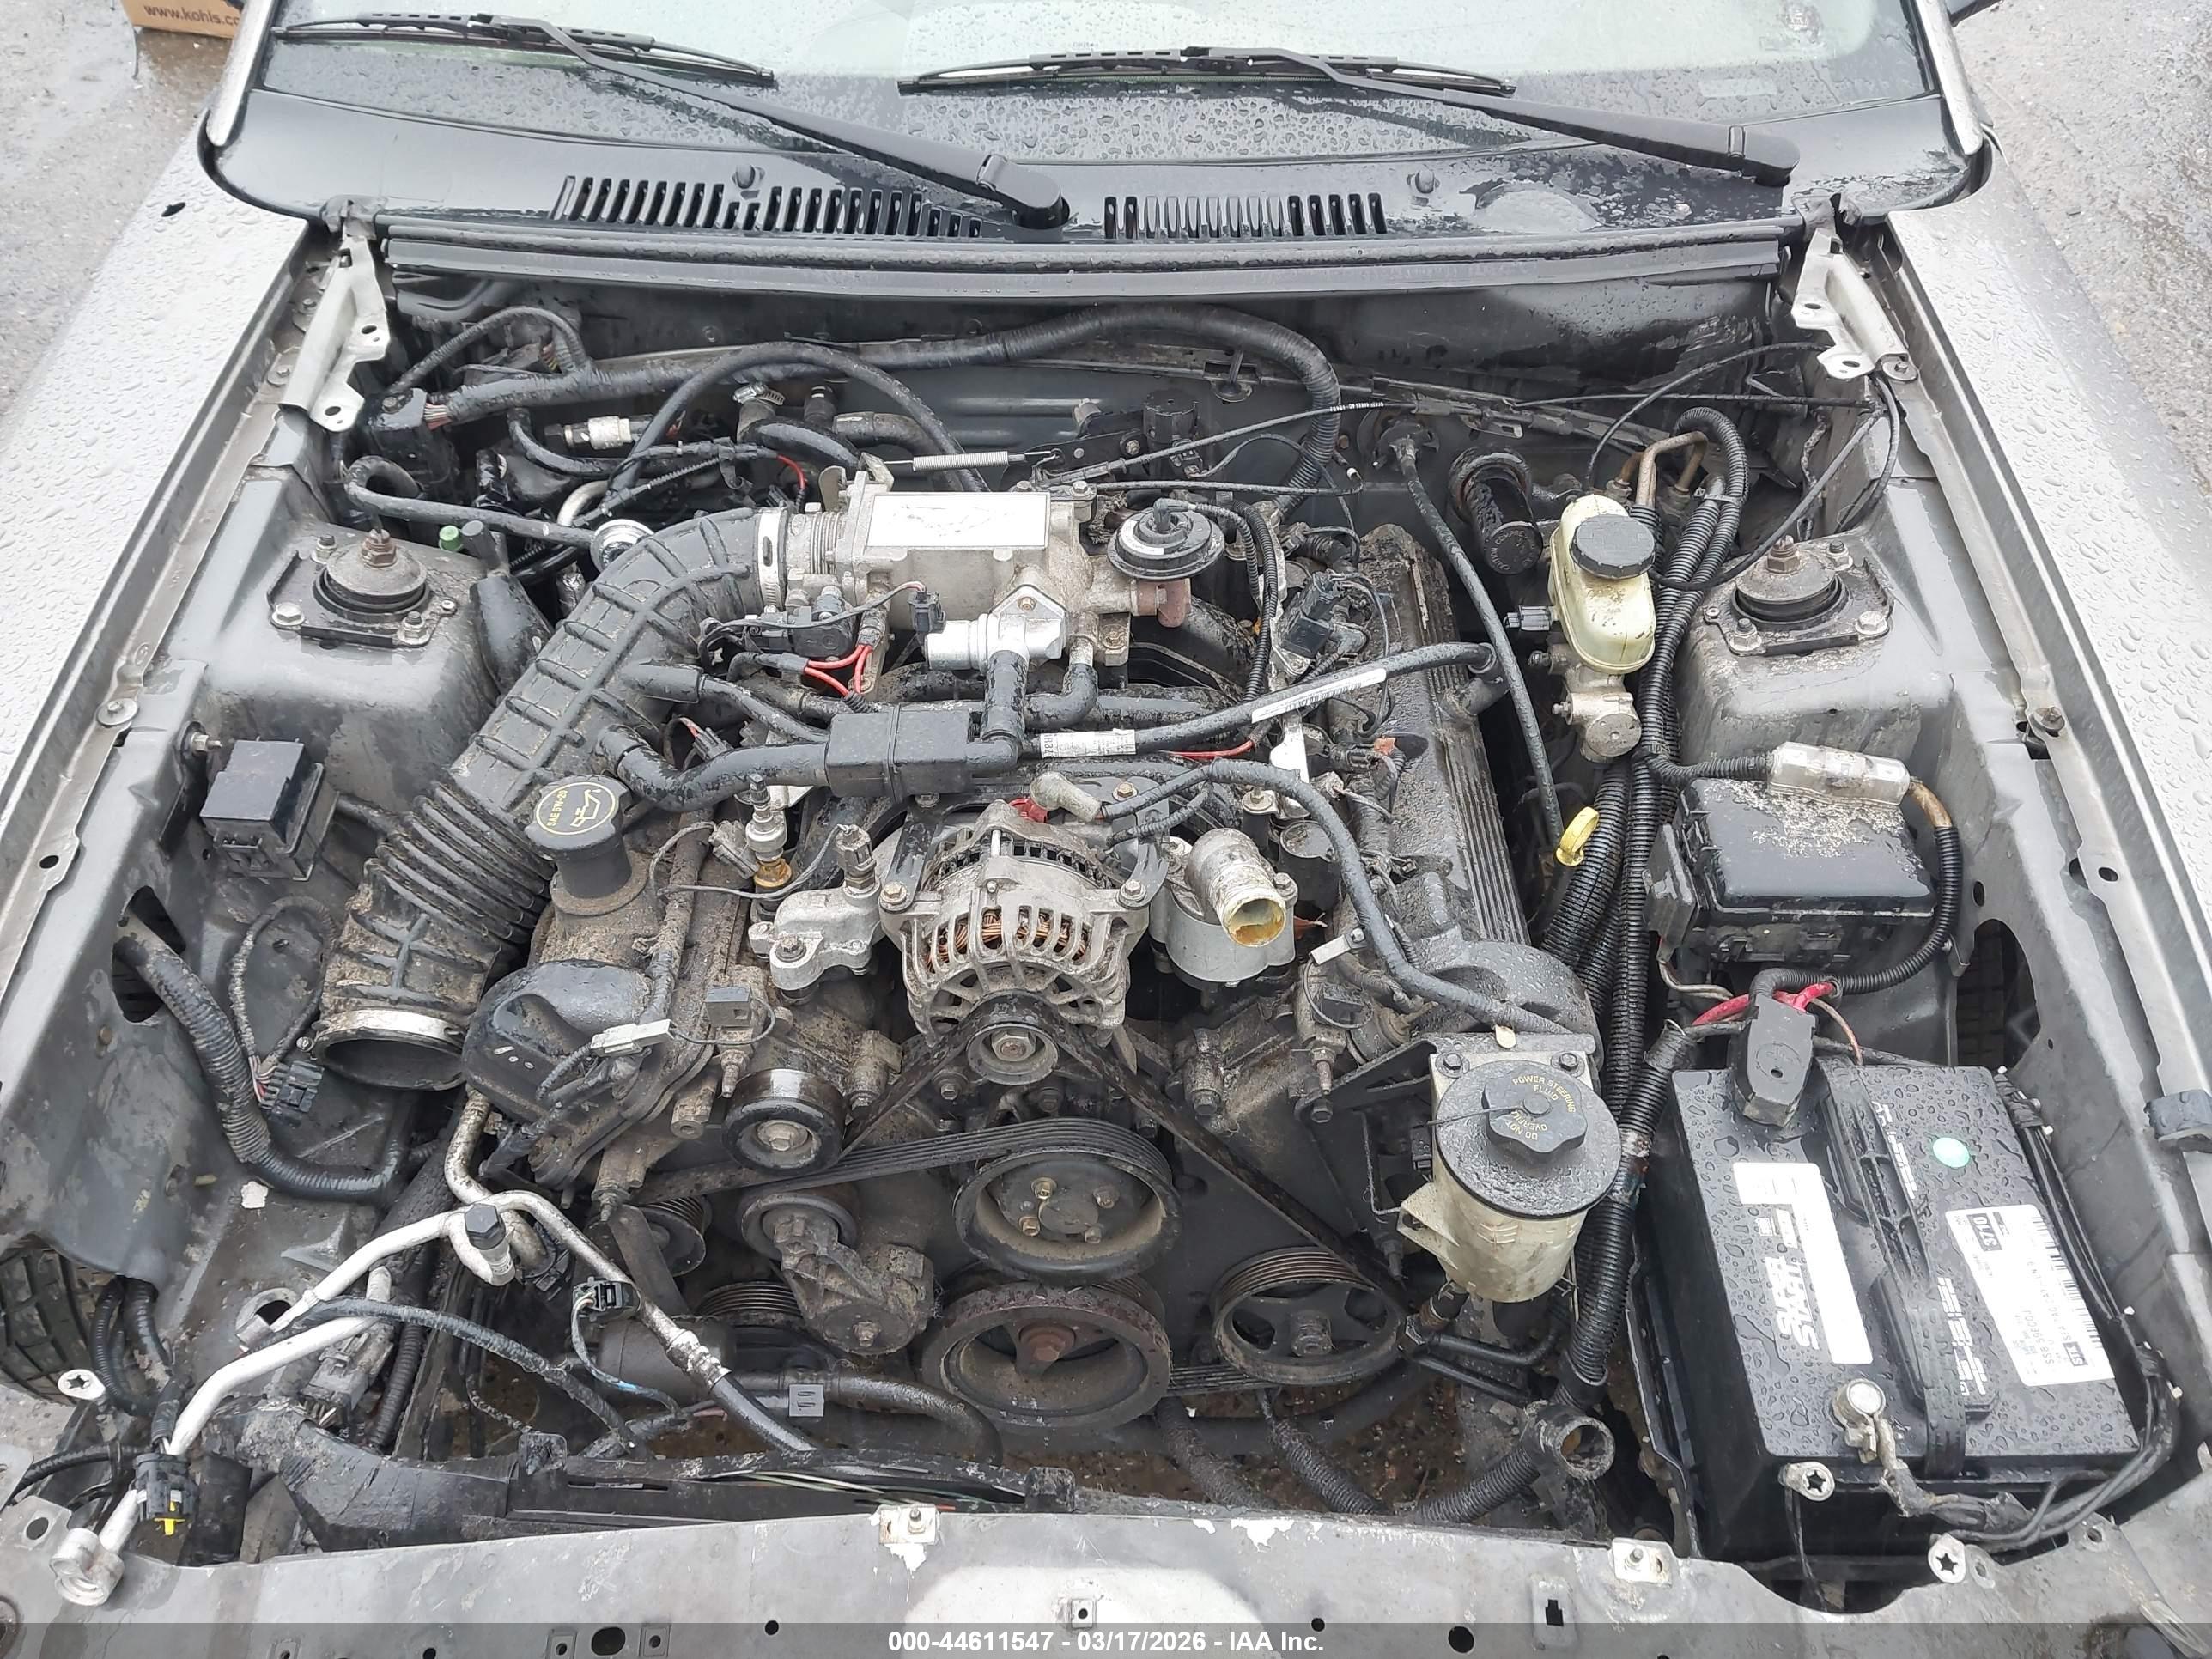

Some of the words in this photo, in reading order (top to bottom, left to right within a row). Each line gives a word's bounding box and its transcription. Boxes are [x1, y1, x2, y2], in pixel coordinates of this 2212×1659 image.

[546, 812, 560, 827] SAE
[1512, 1075, 1546, 1085] POWER
[1547, 1080, 1577, 1113] STEERING
[1534, 1085, 1559, 1101] FLUID
[1505, 1120, 1523, 1134] NOT
[1511, 1109, 1547, 1132] OVERFILL
[1525, 1132, 1538, 1140] DO
[1972, 1216, 1999, 1246] 3710
[2065, 1345, 2084, 1365] STK
